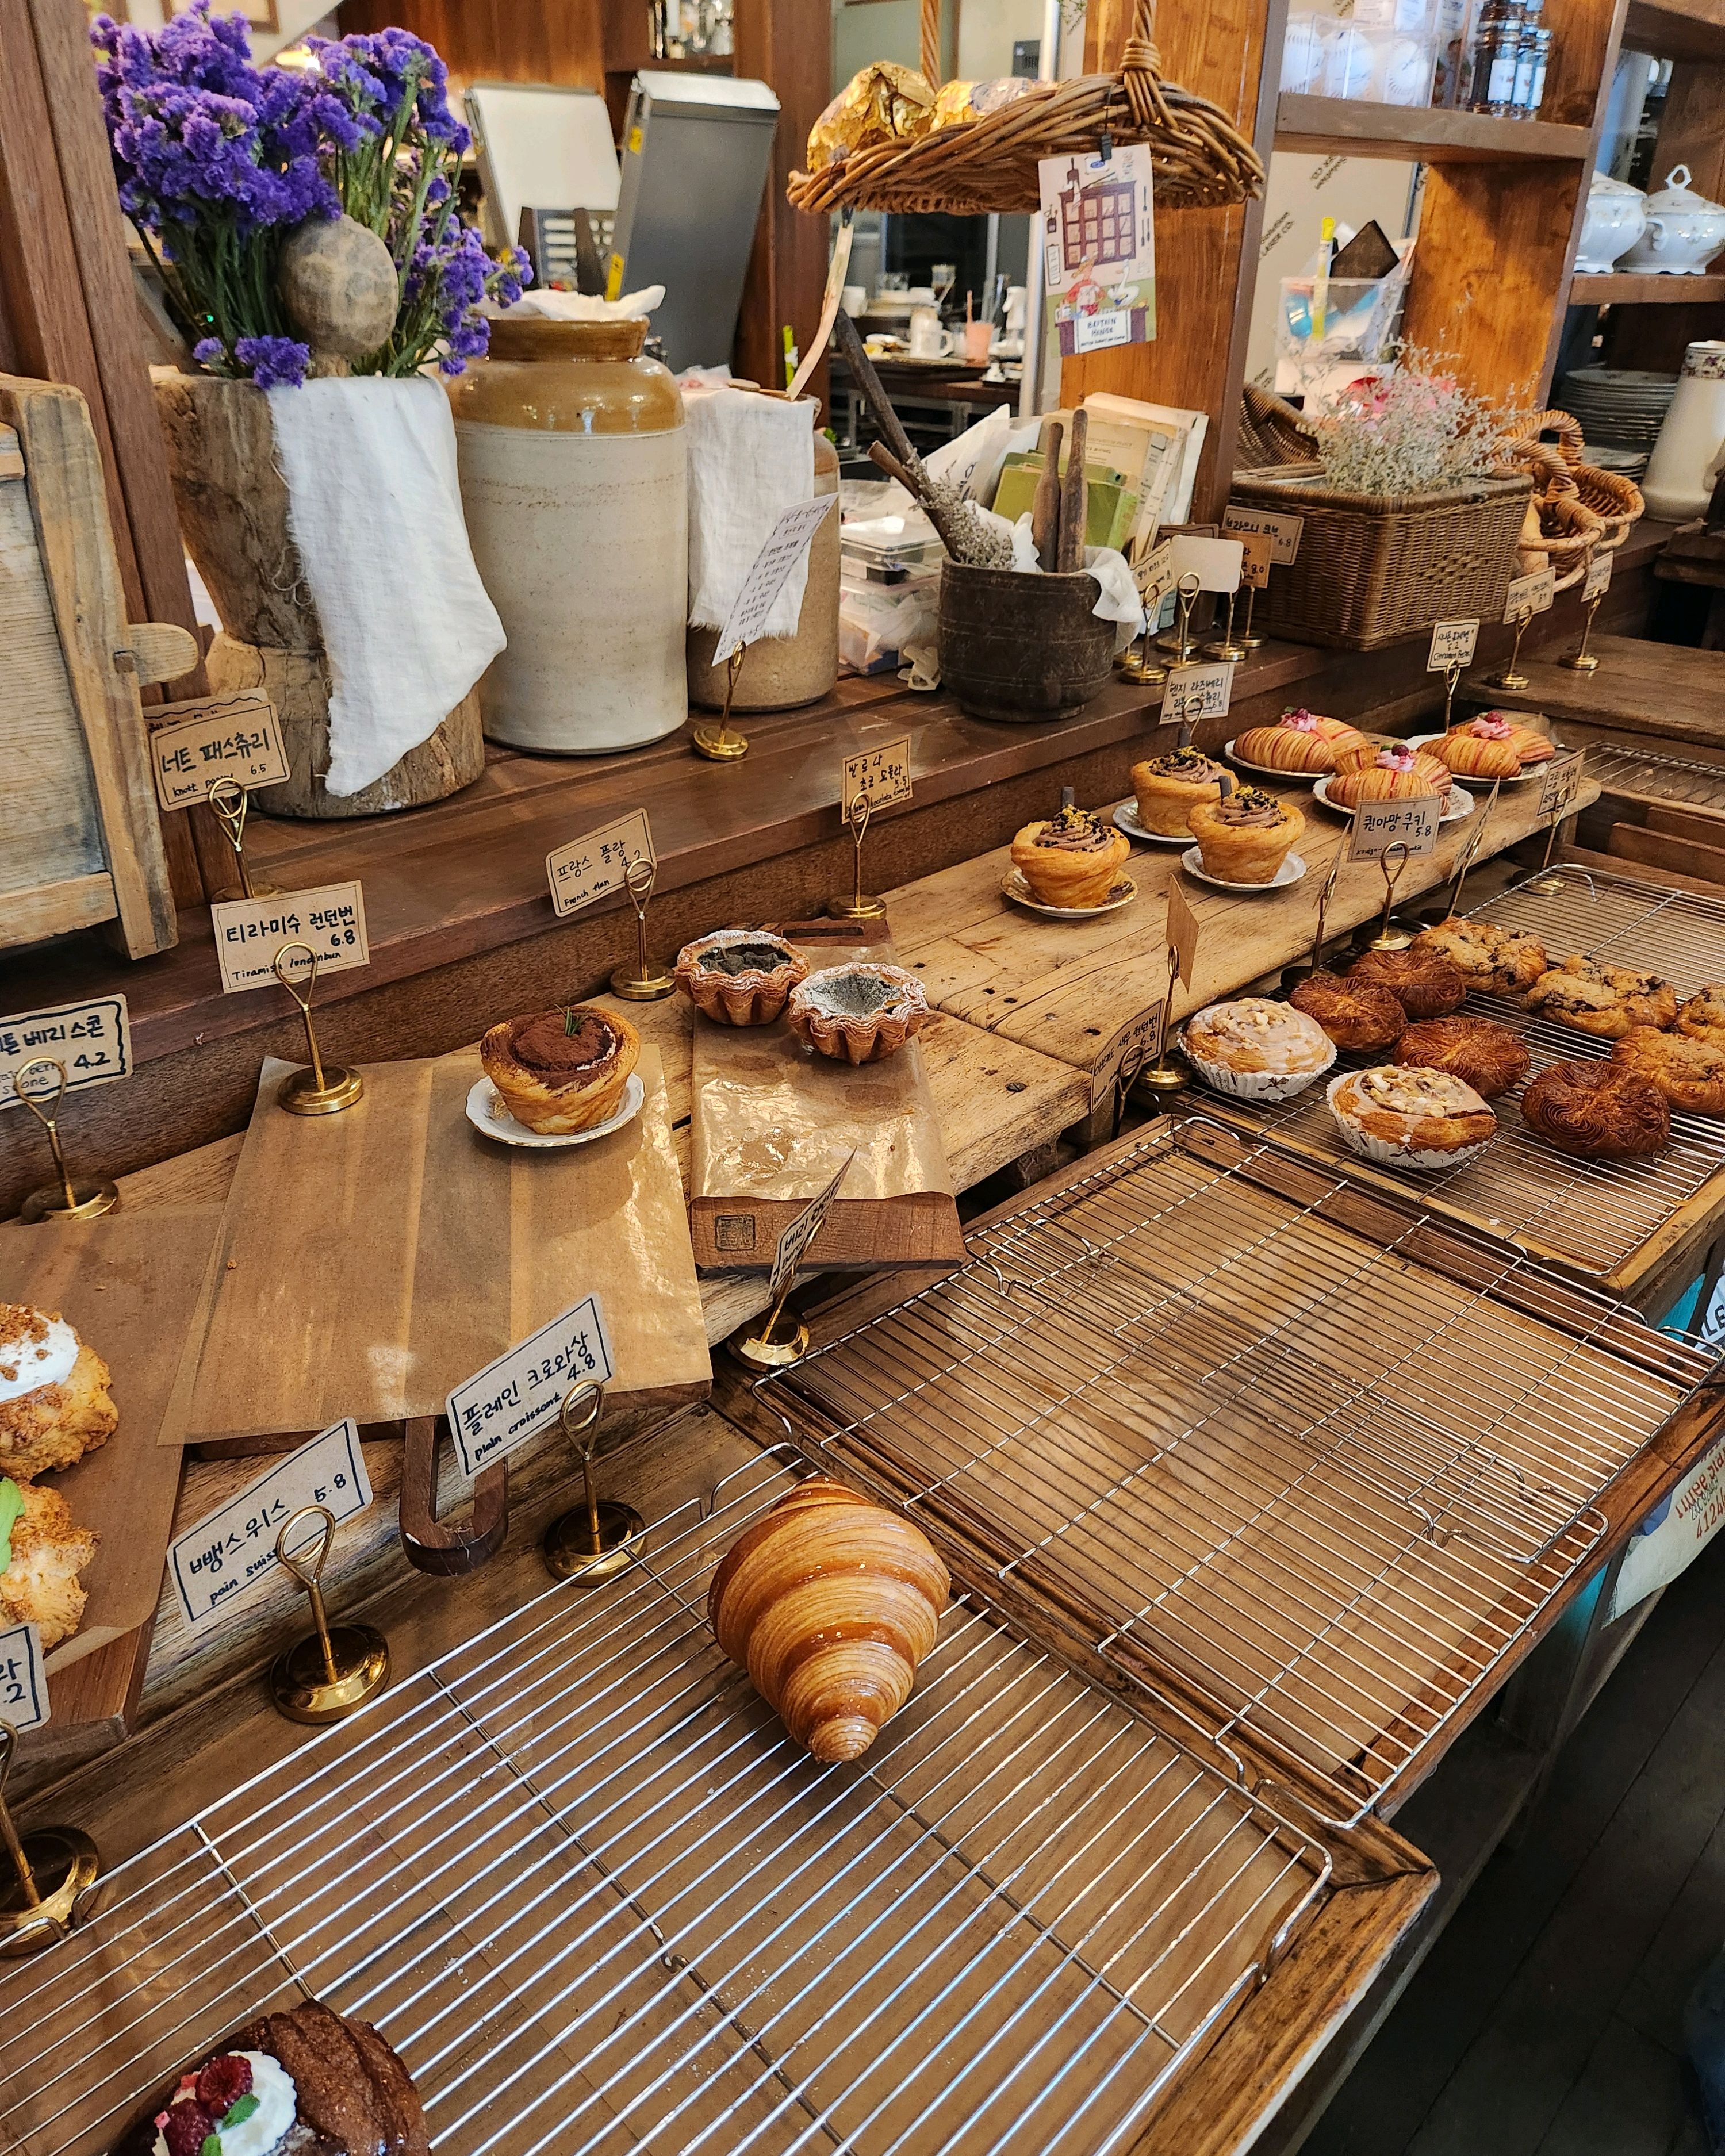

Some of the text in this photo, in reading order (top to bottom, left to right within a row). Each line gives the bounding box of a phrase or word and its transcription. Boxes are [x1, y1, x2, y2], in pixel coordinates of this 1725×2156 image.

[162, 747, 197, 773] 너트
[250, 764, 266, 775] 6.5
[1363, 811, 1425, 832] 퀸아망 쿠키
[1416, 826, 1431, 837] 5.8
[557, 839, 626, 883] 프랑스 플랑
[226, 905, 355, 943] 티라미수 런던번
[331, 929, 356, 946] 6.8
[22, 1025, 66, 1046] 베리
[71, 1015, 105, 1039] 스콘
[1140, 1030, 1156, 1046] 6.8
[73, 1052, 111, 1069] 4.2
[568, 1353, 596, 1381] 4.8
[462, 1330, 588, 1436] 플레인 크로와상
[474, 1435, 503, 1461] plain
[314, 1473, 346, 1503] 5.8
[209, 1579, 239, 1606] pain
